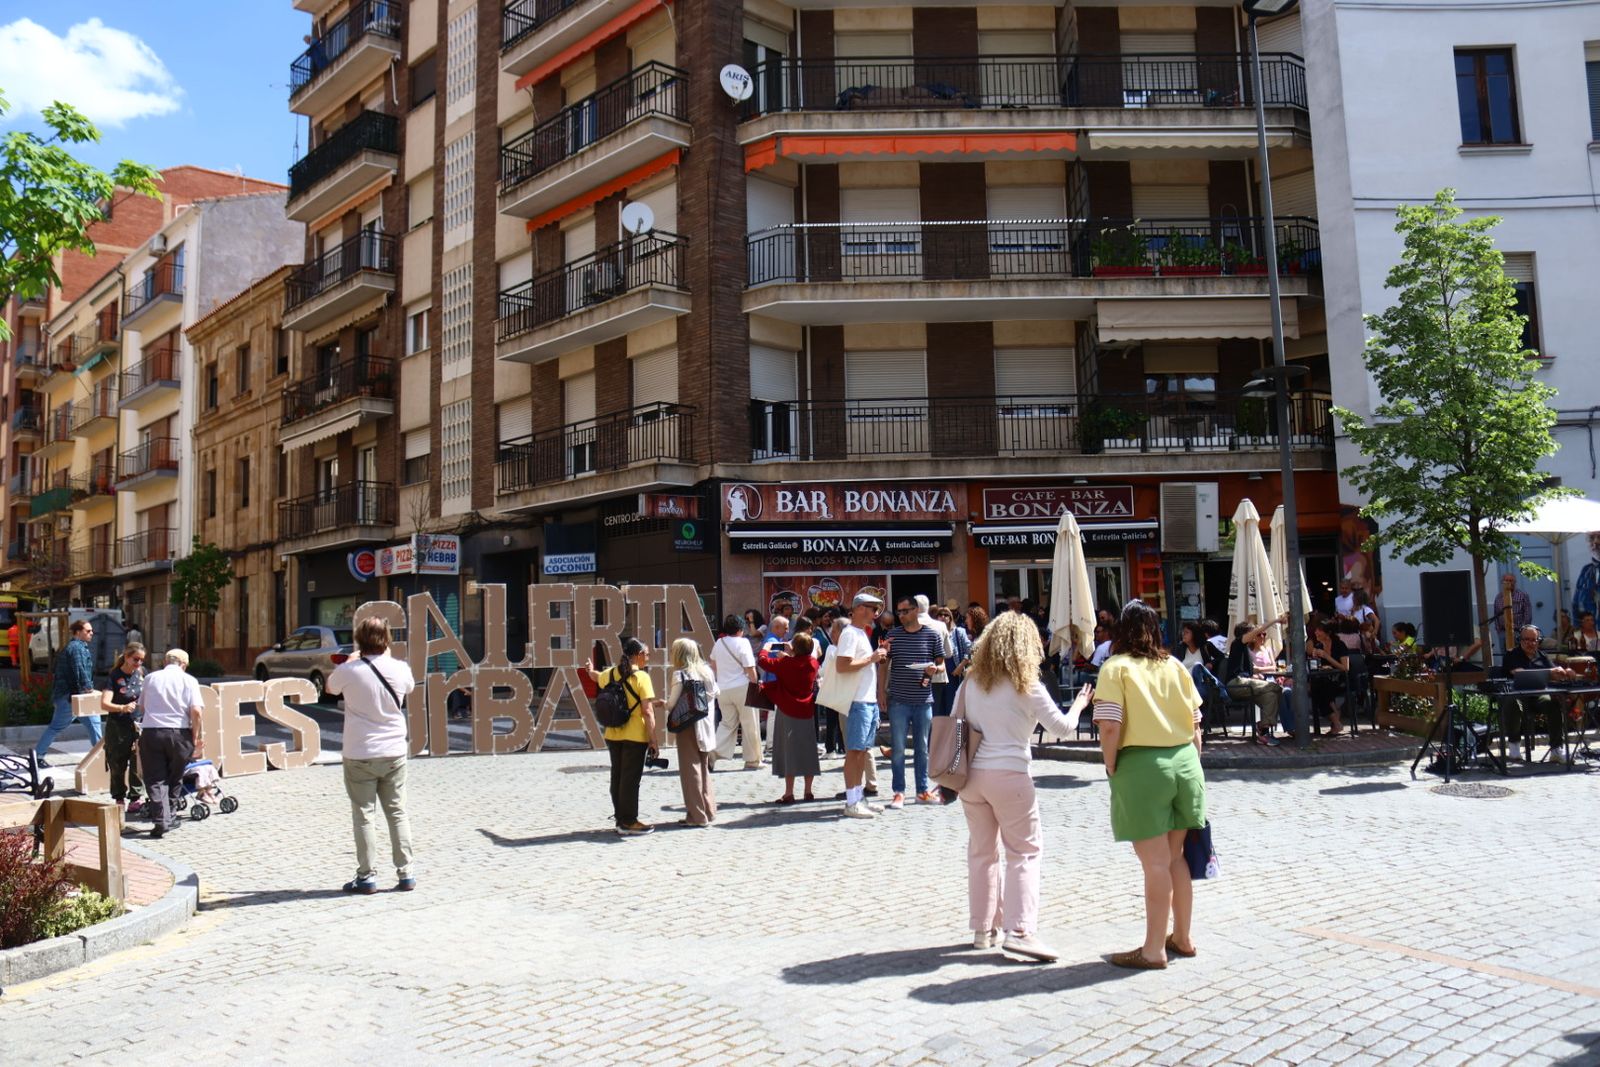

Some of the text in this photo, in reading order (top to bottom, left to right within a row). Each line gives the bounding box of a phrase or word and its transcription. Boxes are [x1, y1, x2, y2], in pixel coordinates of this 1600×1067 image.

[1011, 491, 1056, 501] CAFE
[1071, 490, 1106, 500] BAR
[777, 489, 957, 518] BAR BONANZA
[990, 500, 1129, 517] BONANZA
[604, 513, 630, 526] CENTRO
[885, 540, 934, 549] Estrella Galicia
[980, 533, 1087, 545] CAFE-BAR BONA
[742, 541, 792, 550] Estrella Galicia
[802, 539, 881, 553] BONANZA
[428, 552, 457, 563] KEBAB
[549, 556, 590, 564] ASOCIACIÓN
[765, 555, 936, 566] COMBINADOS TAPAS RACIONES
[545, 563, 594, 573] COCONUT
